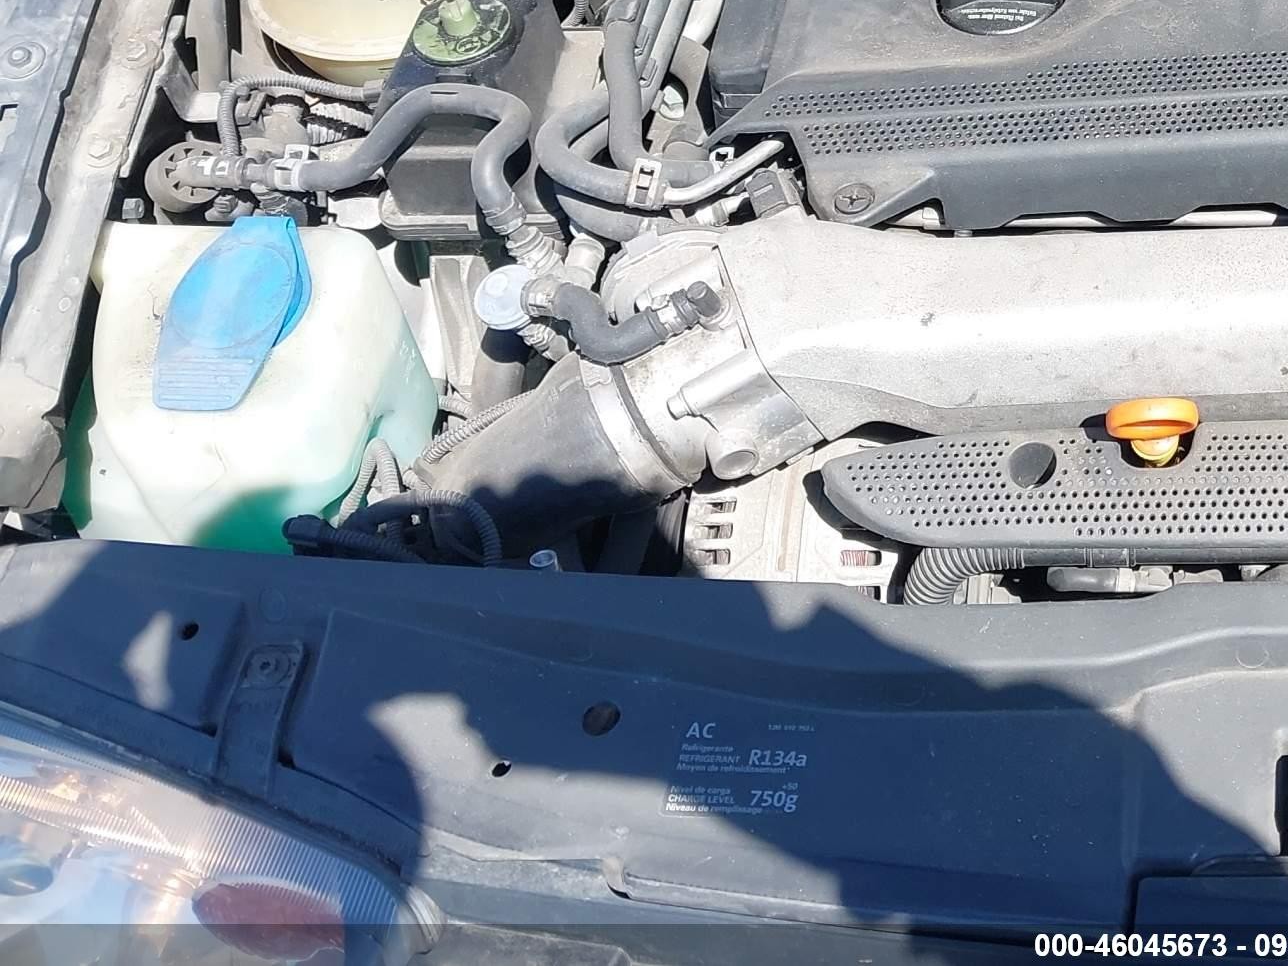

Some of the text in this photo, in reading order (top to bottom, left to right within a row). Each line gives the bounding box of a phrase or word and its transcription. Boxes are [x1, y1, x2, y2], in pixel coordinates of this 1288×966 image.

[686, 722, 716, 738] AC
[679, 749, 807, 767] REFRIGERANT R134a
[670, 785, 693, 794] Nivel
[707, 787, 731, 796] carga
[666, 802, 696, 812] Niveau
[698, 804, 709, 812] de
[668, 791, 798, 813] CHARGE LEVEL 750g
